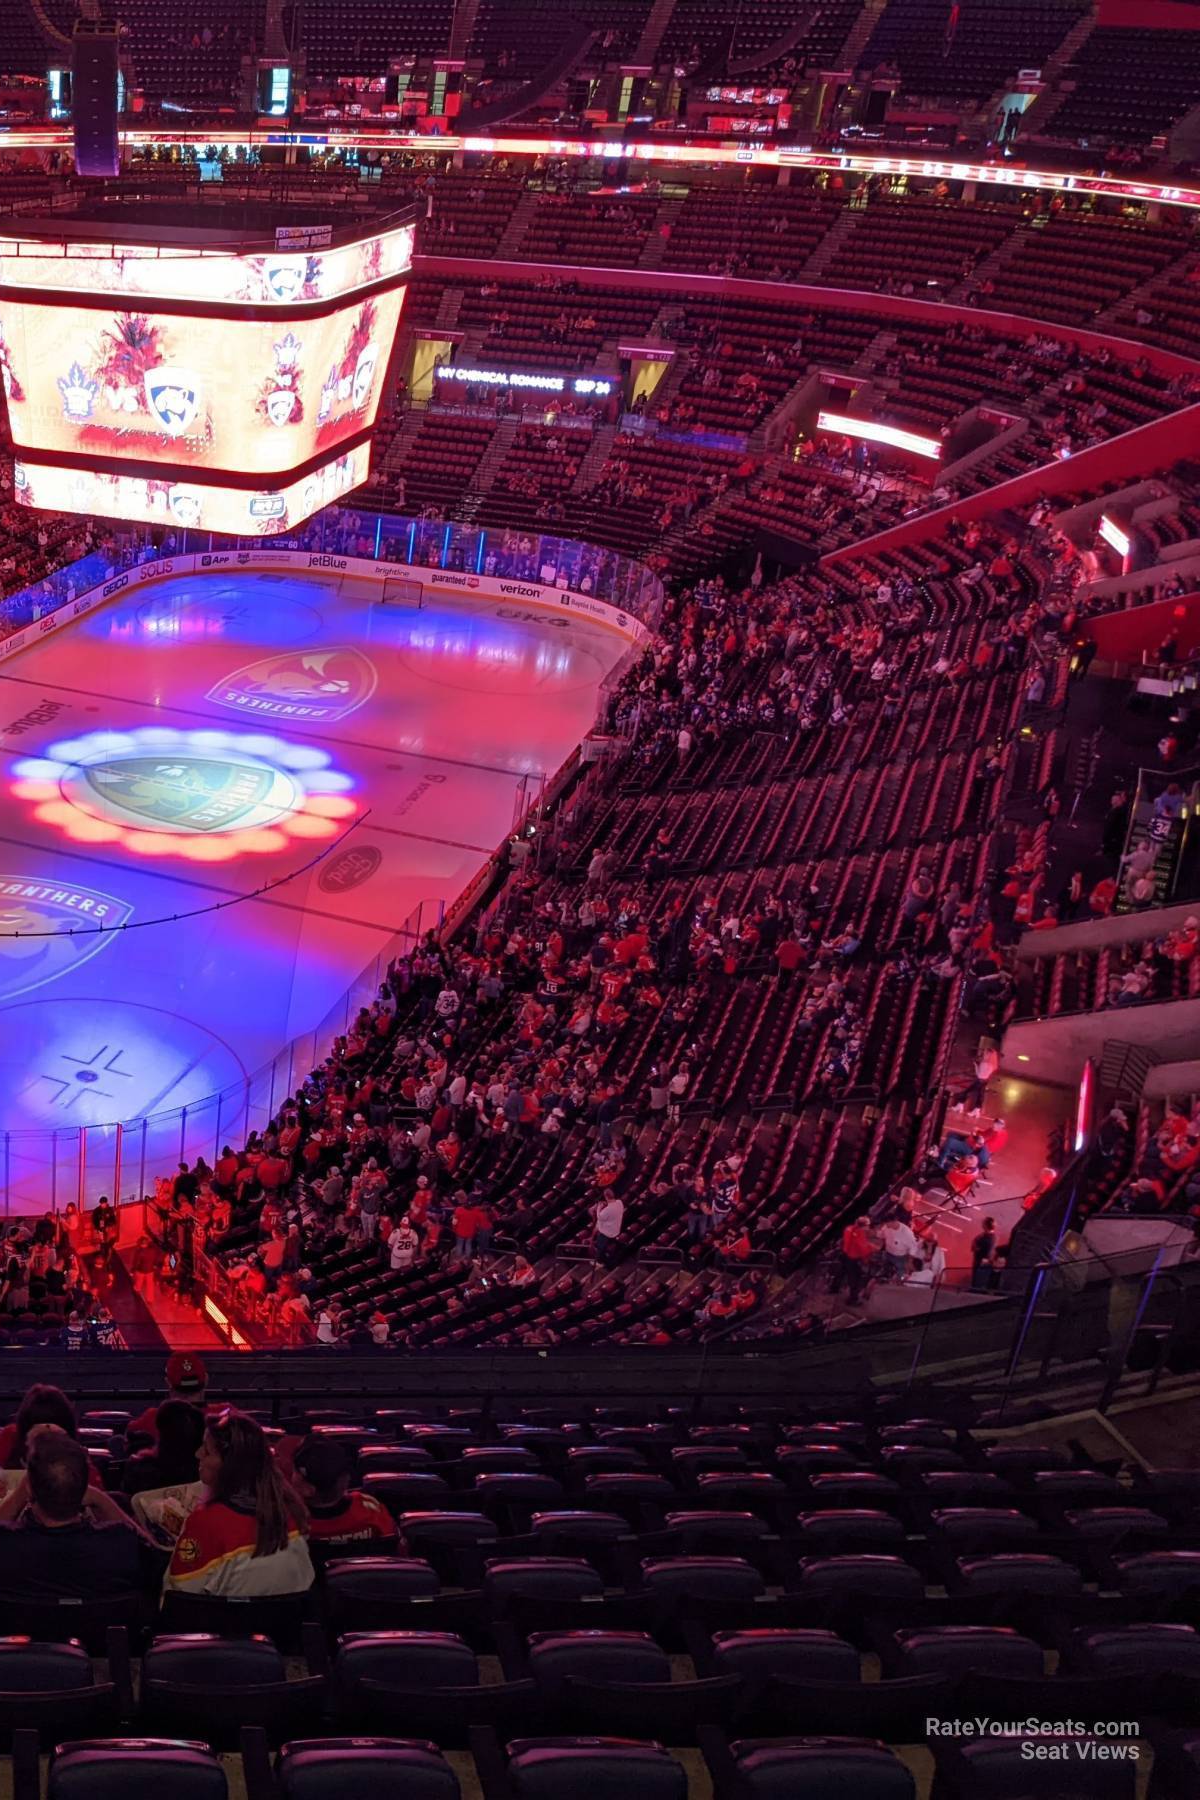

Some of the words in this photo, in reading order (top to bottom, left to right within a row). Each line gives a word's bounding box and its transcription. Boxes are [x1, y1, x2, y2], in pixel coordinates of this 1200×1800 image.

[455, 368, 510, 384] CHEMICAL
[510, 374, 564, 390] ROMANCE
[139, 560, 173, 580] SOLIS
[307, 554, 347, 569] jetBlue
[375, 566, 410, 578] brightline
[431, 573, 467, 586] guaranteed
[102, 574, 128, 597] GEICO
[500, 583, 540, 598] verizon
[225, 692, 329, 717] PANTHERS
[191, 772, 260, 823] PANTHERS
